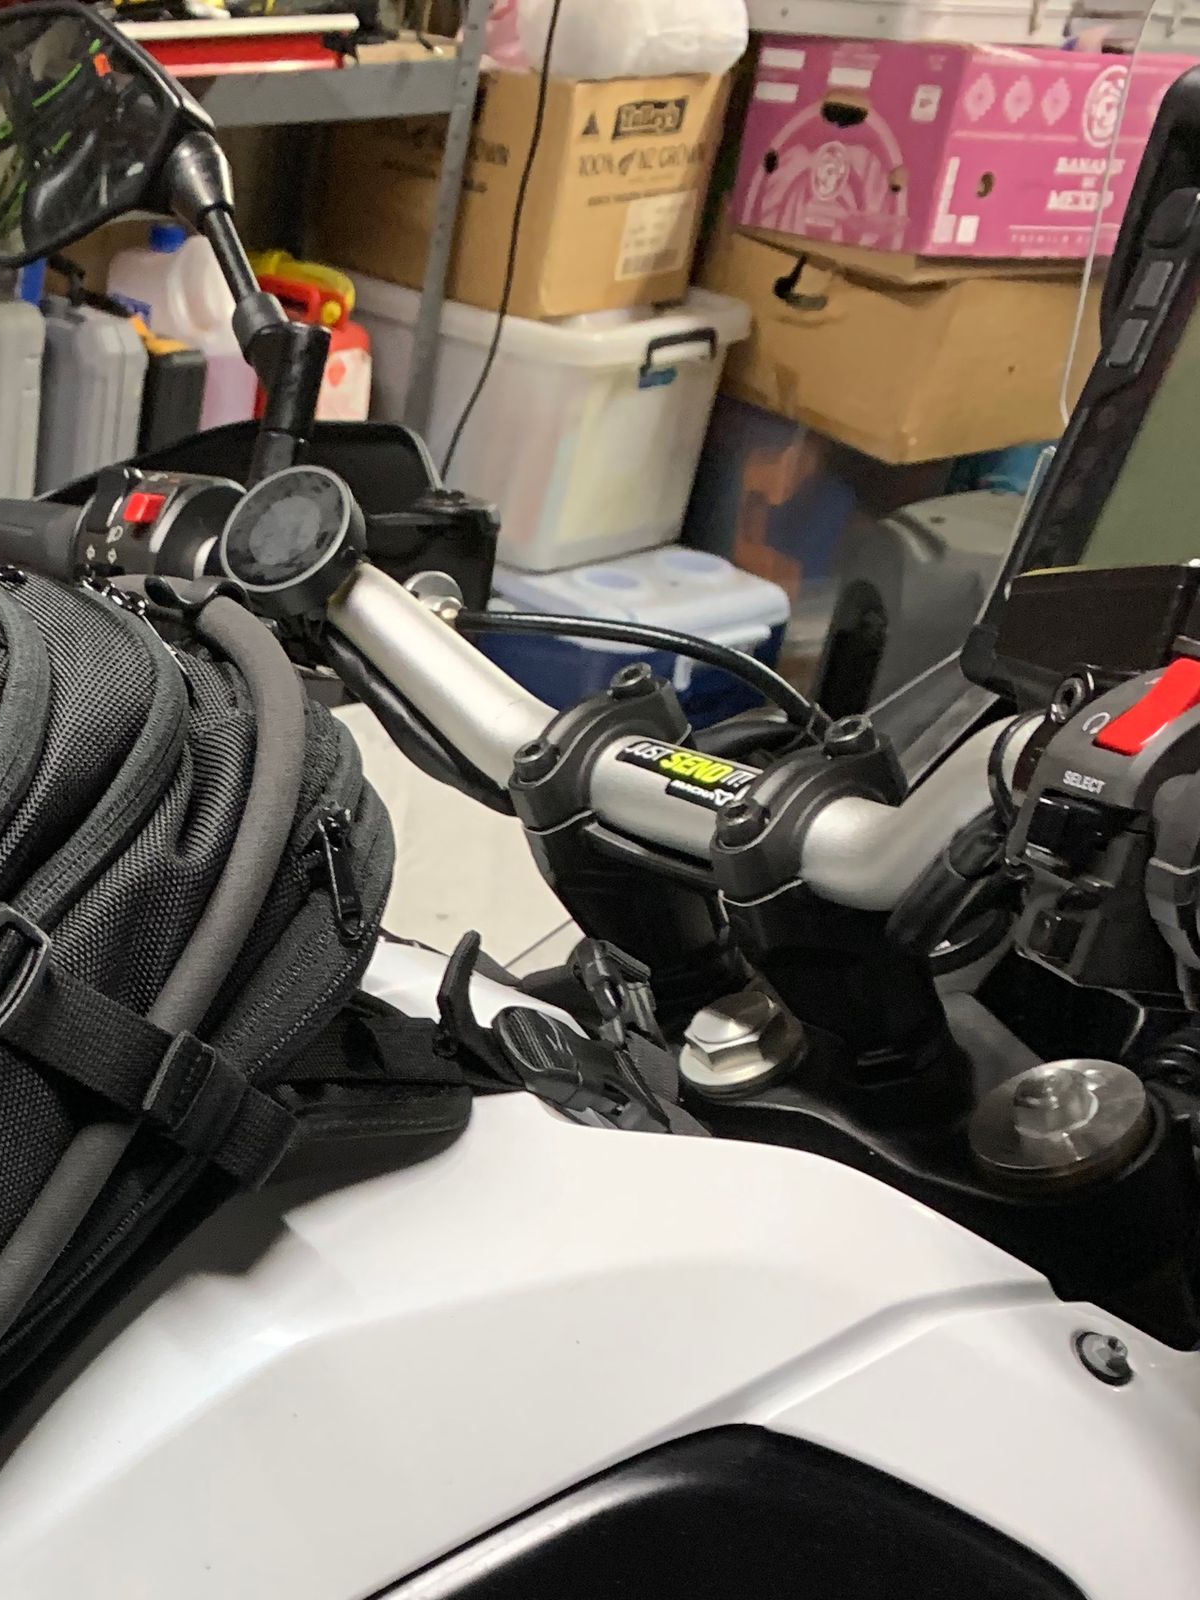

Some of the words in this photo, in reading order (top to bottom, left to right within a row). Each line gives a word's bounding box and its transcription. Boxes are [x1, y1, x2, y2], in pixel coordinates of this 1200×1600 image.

[625, 742, 674, 761] JUST
[660, 752, 733, 783] SEND
[1063, 770, 1106, 794] SELECT
